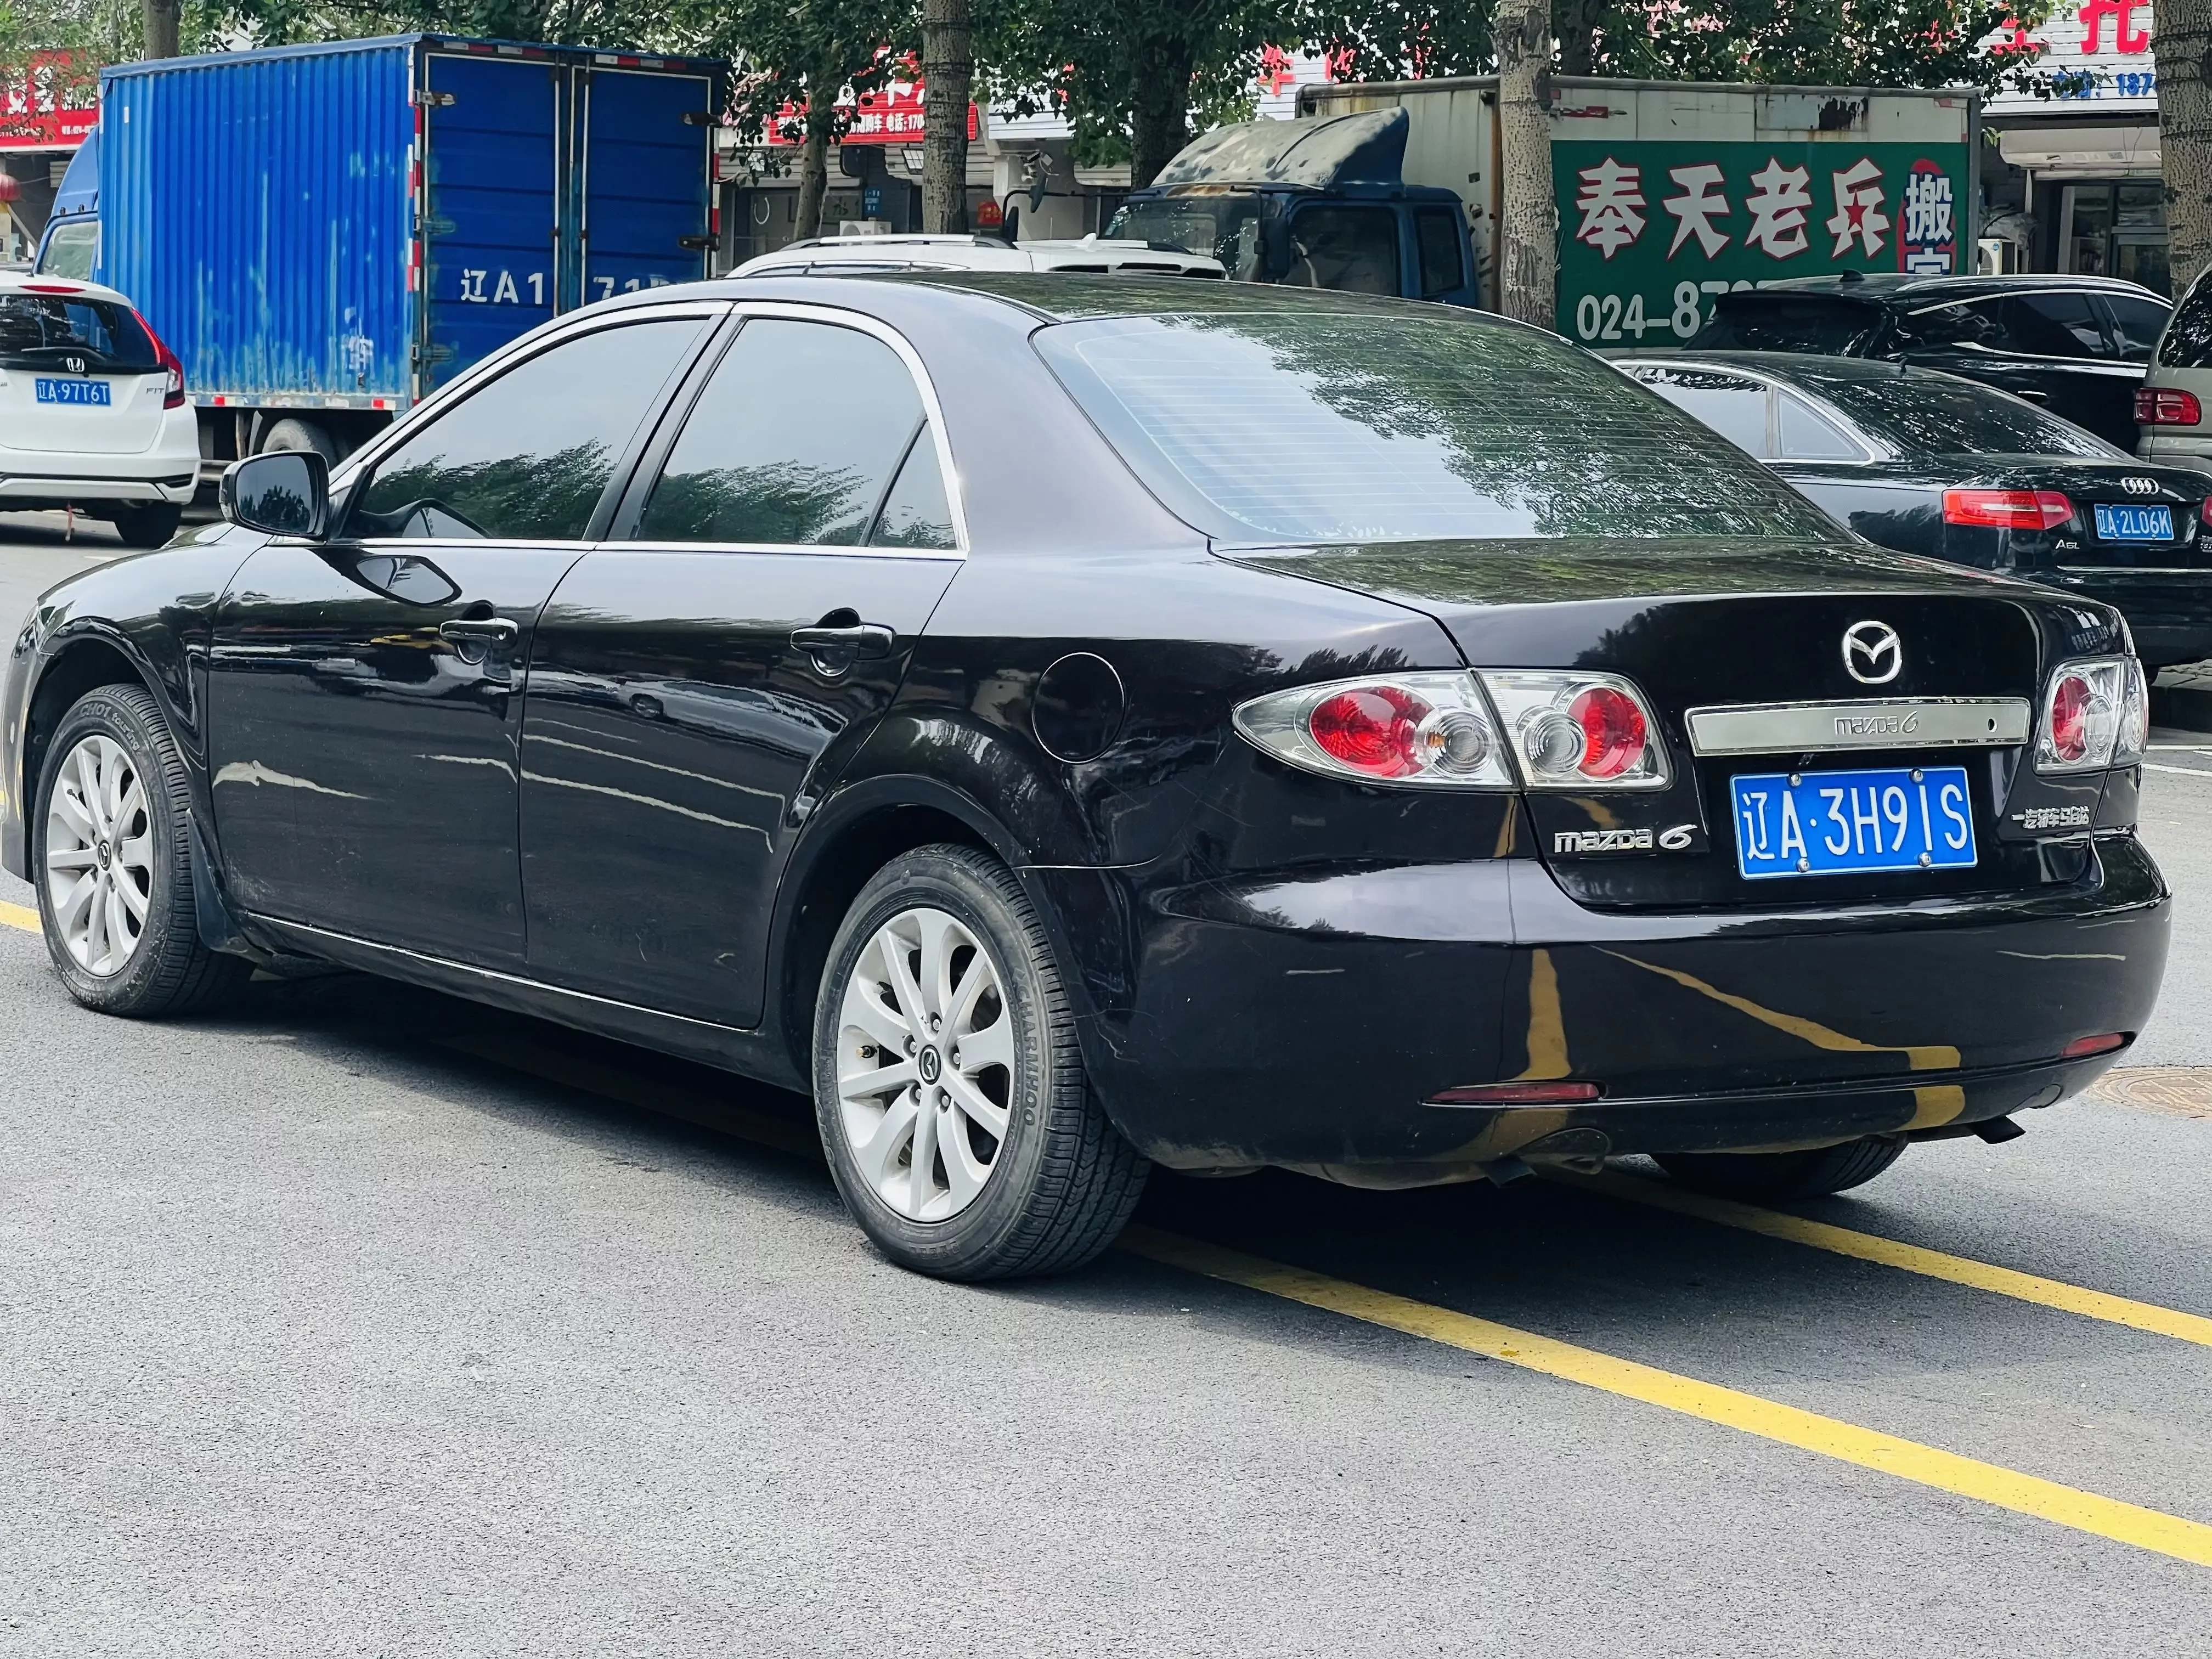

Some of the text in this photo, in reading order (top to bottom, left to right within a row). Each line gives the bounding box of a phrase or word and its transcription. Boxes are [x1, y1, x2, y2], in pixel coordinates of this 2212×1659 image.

[2116, 72, 2157, 97] 187
[1576, 155, 1891, 262] 奉天老兵
[2056, 539, 2080, 549] A6L
